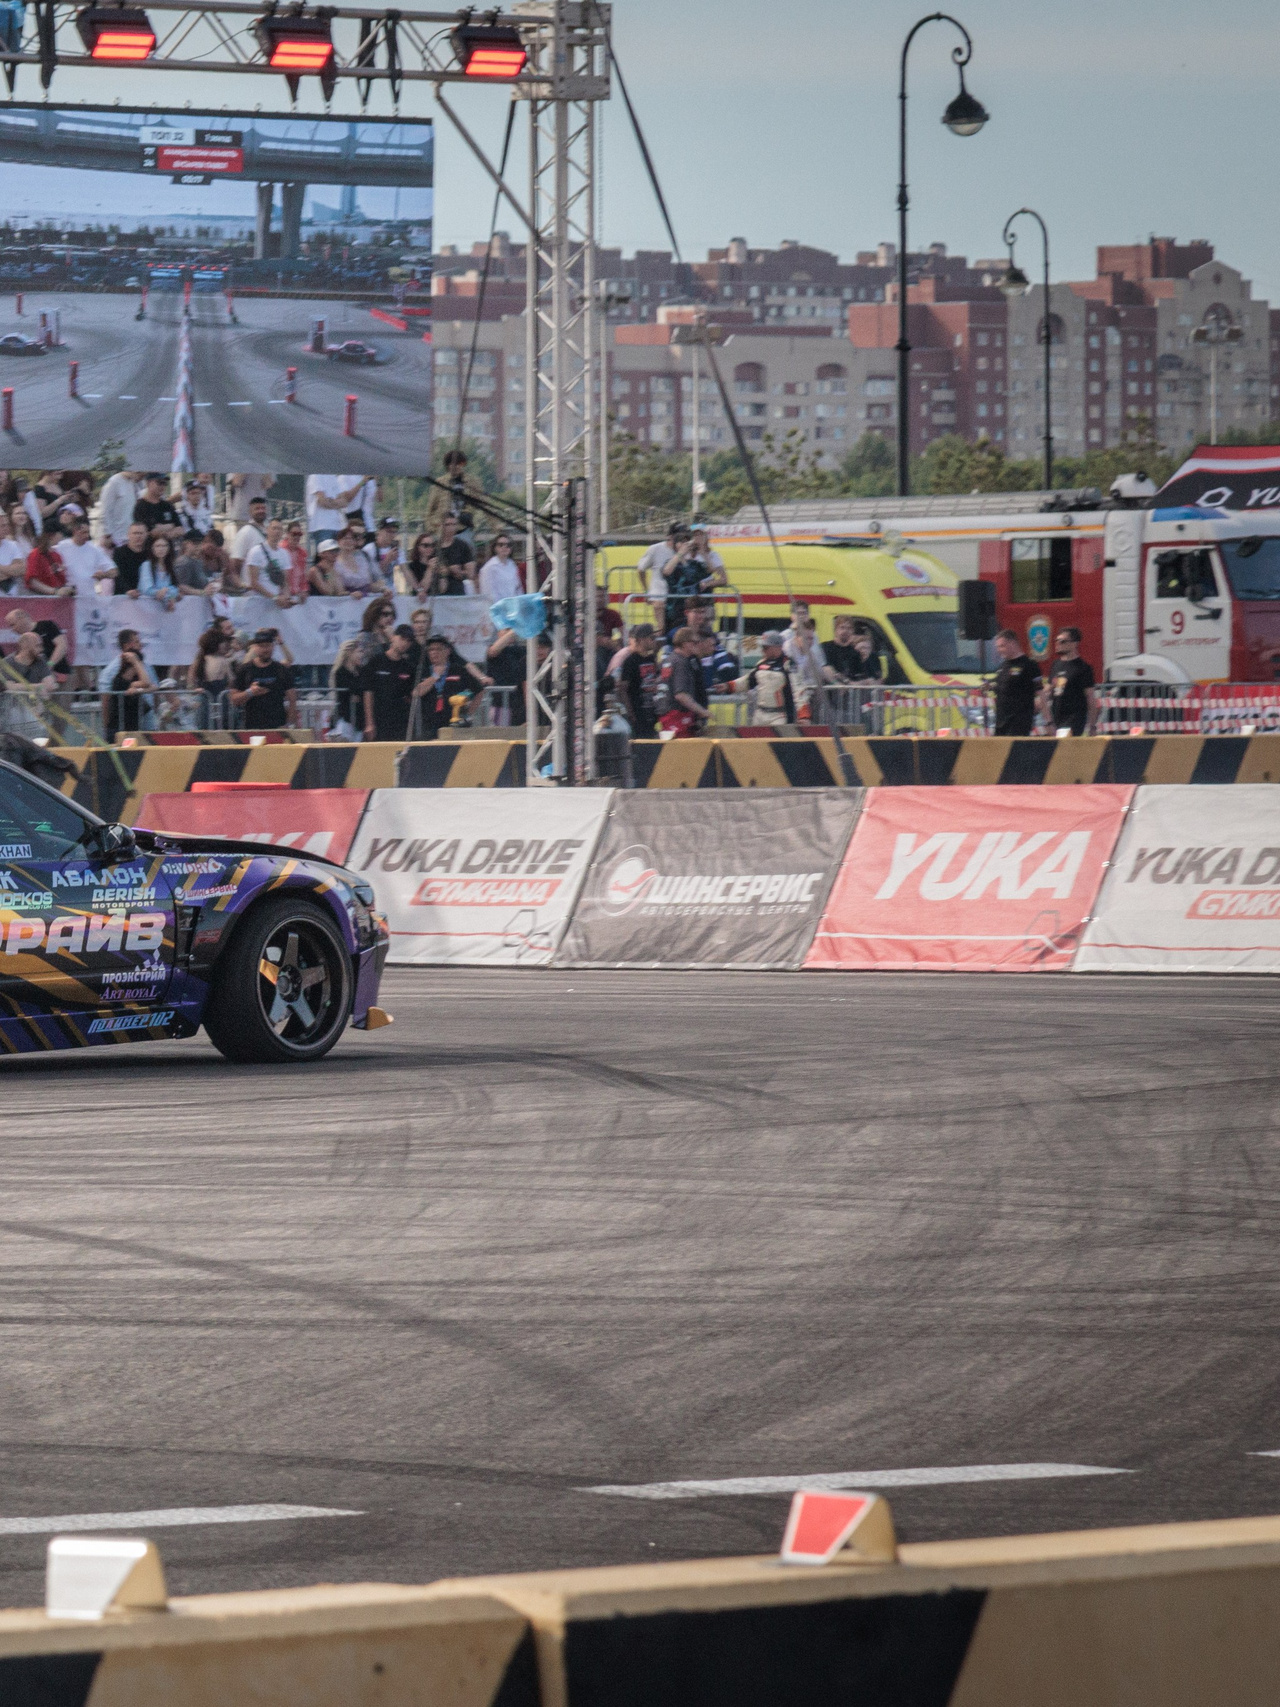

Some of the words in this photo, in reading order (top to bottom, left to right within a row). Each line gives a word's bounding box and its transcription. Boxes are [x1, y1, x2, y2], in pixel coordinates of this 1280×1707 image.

[1171, 610, 1185, 634] 9
[359, 838, 461, 873] YUKA
[458, 839, 586, 874] DRIVE
[874, 831, 1094, 900] YUKA
[1124, 847, 1245, 885] YUKA
[92, 887, 156, 902] BERISH
[422, 879, 549, 903] GYMKHANA
[646, 872, 825, 904] ШИНСЕРВИС
[92, 901, 155, 909] MOTORSPORT
[102, 970, 166, 984] ПРОЭКСТРИМ
[102, 987, 124, 999] ART
[125, 987, 159, 999] ROYAL
